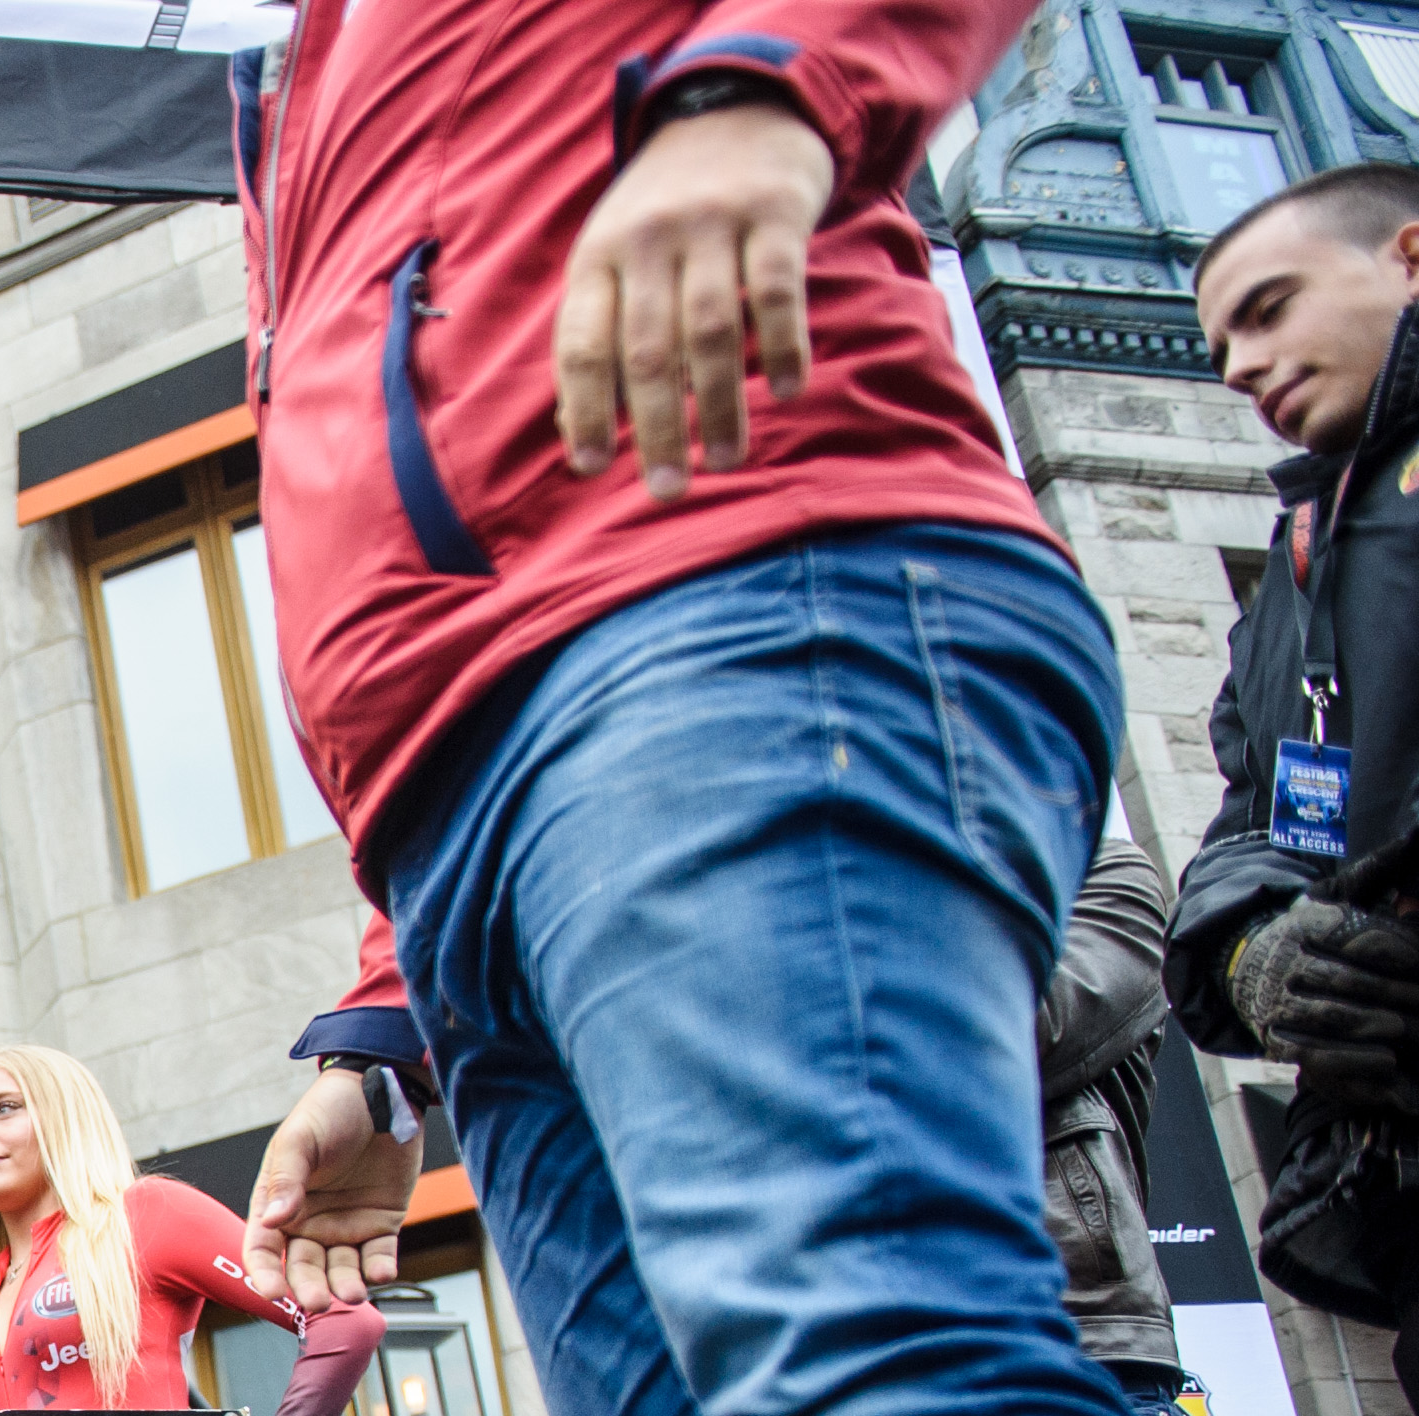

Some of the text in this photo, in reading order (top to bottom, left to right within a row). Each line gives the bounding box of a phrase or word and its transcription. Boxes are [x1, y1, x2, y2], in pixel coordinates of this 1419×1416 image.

[1273, 833, 1345, 853] ALL ACCESS
[46, 1281, 76, 1307] FIA
[41, 1342, 93, 1371] Jee
